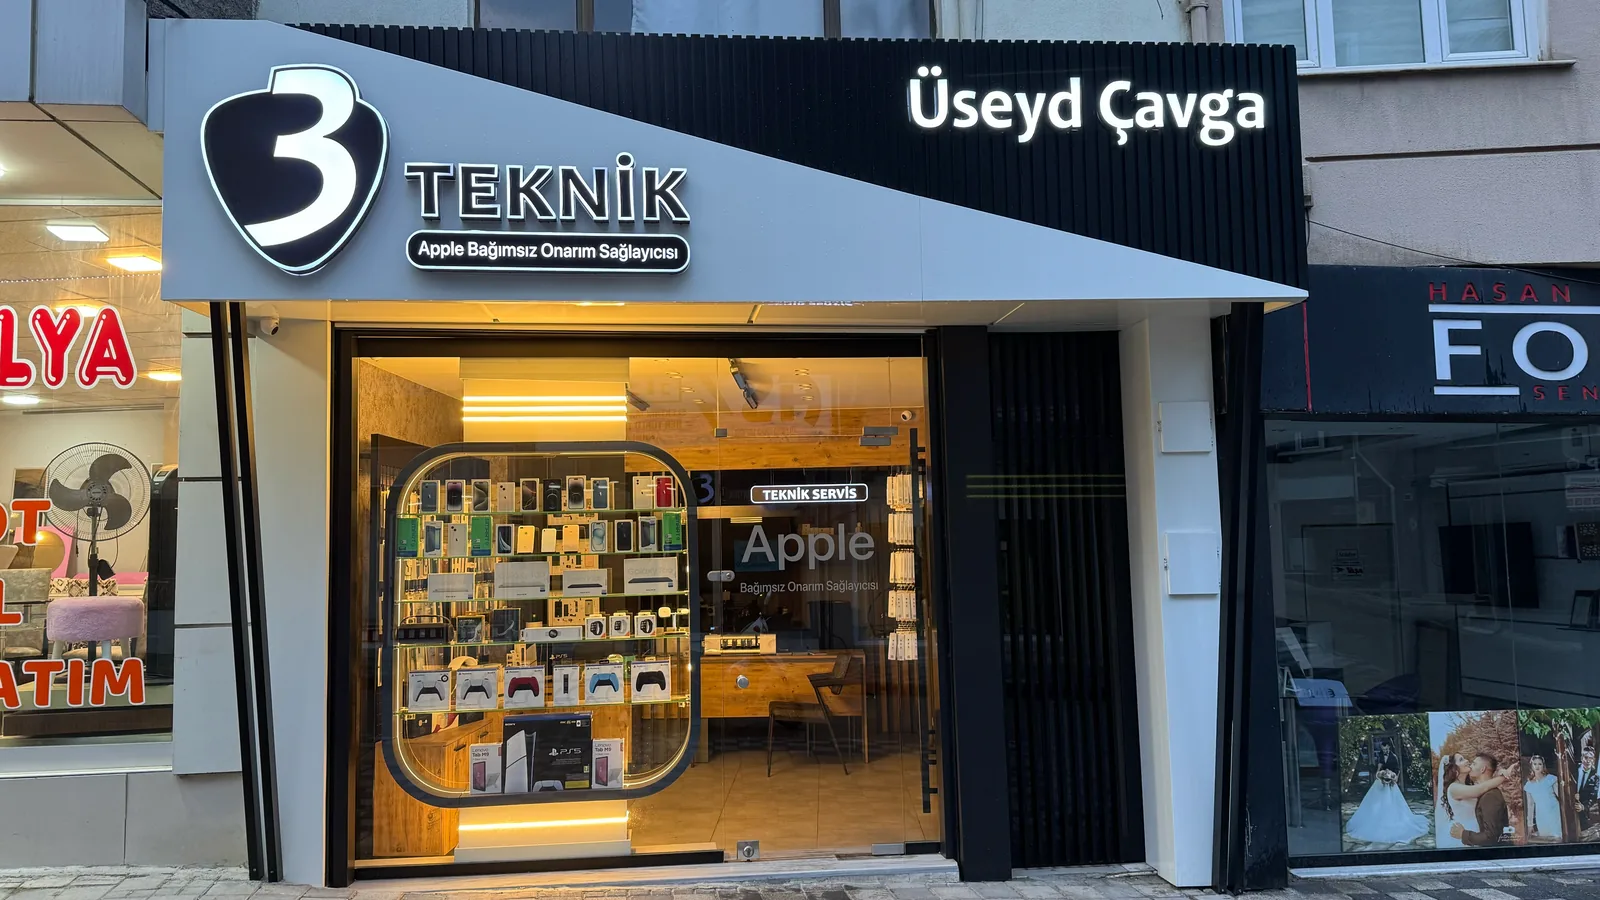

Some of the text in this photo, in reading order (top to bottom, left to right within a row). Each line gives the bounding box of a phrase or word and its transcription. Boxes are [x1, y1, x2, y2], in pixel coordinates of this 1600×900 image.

[907, 65, 1267, 147] Üseyd Çavga
[242, 67, 356, 250] 3
[404, 151, 691, 223] TEKNİK
[418, 239, 680, 264] Apple Bağımsız Onarım Sağlayıcısı
[1429, 282, 1571, 304] HASAN
[762, 487, 810, 500] TEKNİK
[812, 486, 857, 500] SERVİS
[0, 499, 52, 546] T
[741, 523, 875, 571] Apple
[740, 579, 879, 596] Bağımsız Onarım Sağlayıcısı
[559, 747, 582, 755] PS5
